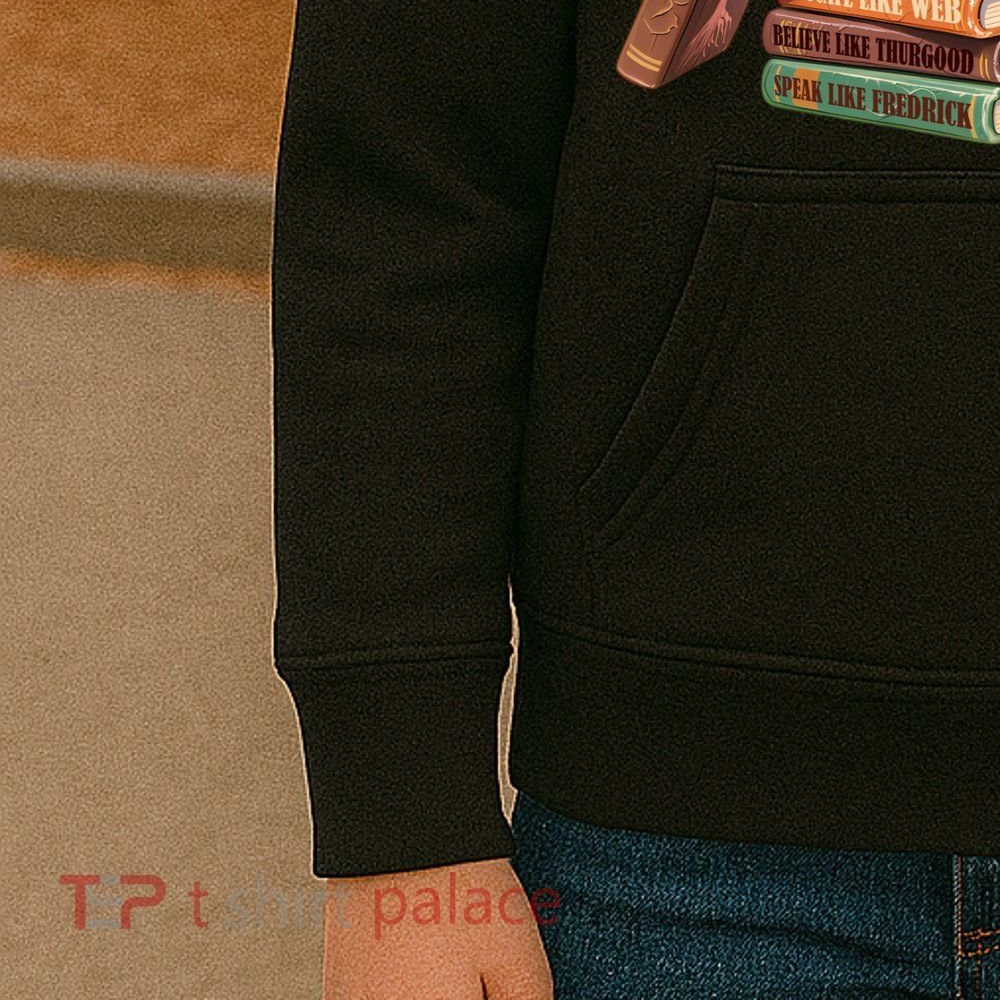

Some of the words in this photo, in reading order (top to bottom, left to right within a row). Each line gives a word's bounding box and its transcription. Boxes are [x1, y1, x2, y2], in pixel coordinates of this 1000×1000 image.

[773, 23, 831, 53] BELIEVE
[835, 30, 871, 59] LIKE
[875, 37, 975, 75] THURGOOD
[774, 75, 822, 105] SPEAK
[828, 80, 866, 111] LIKE
[872, 88, 973, 129] FREDRICK
